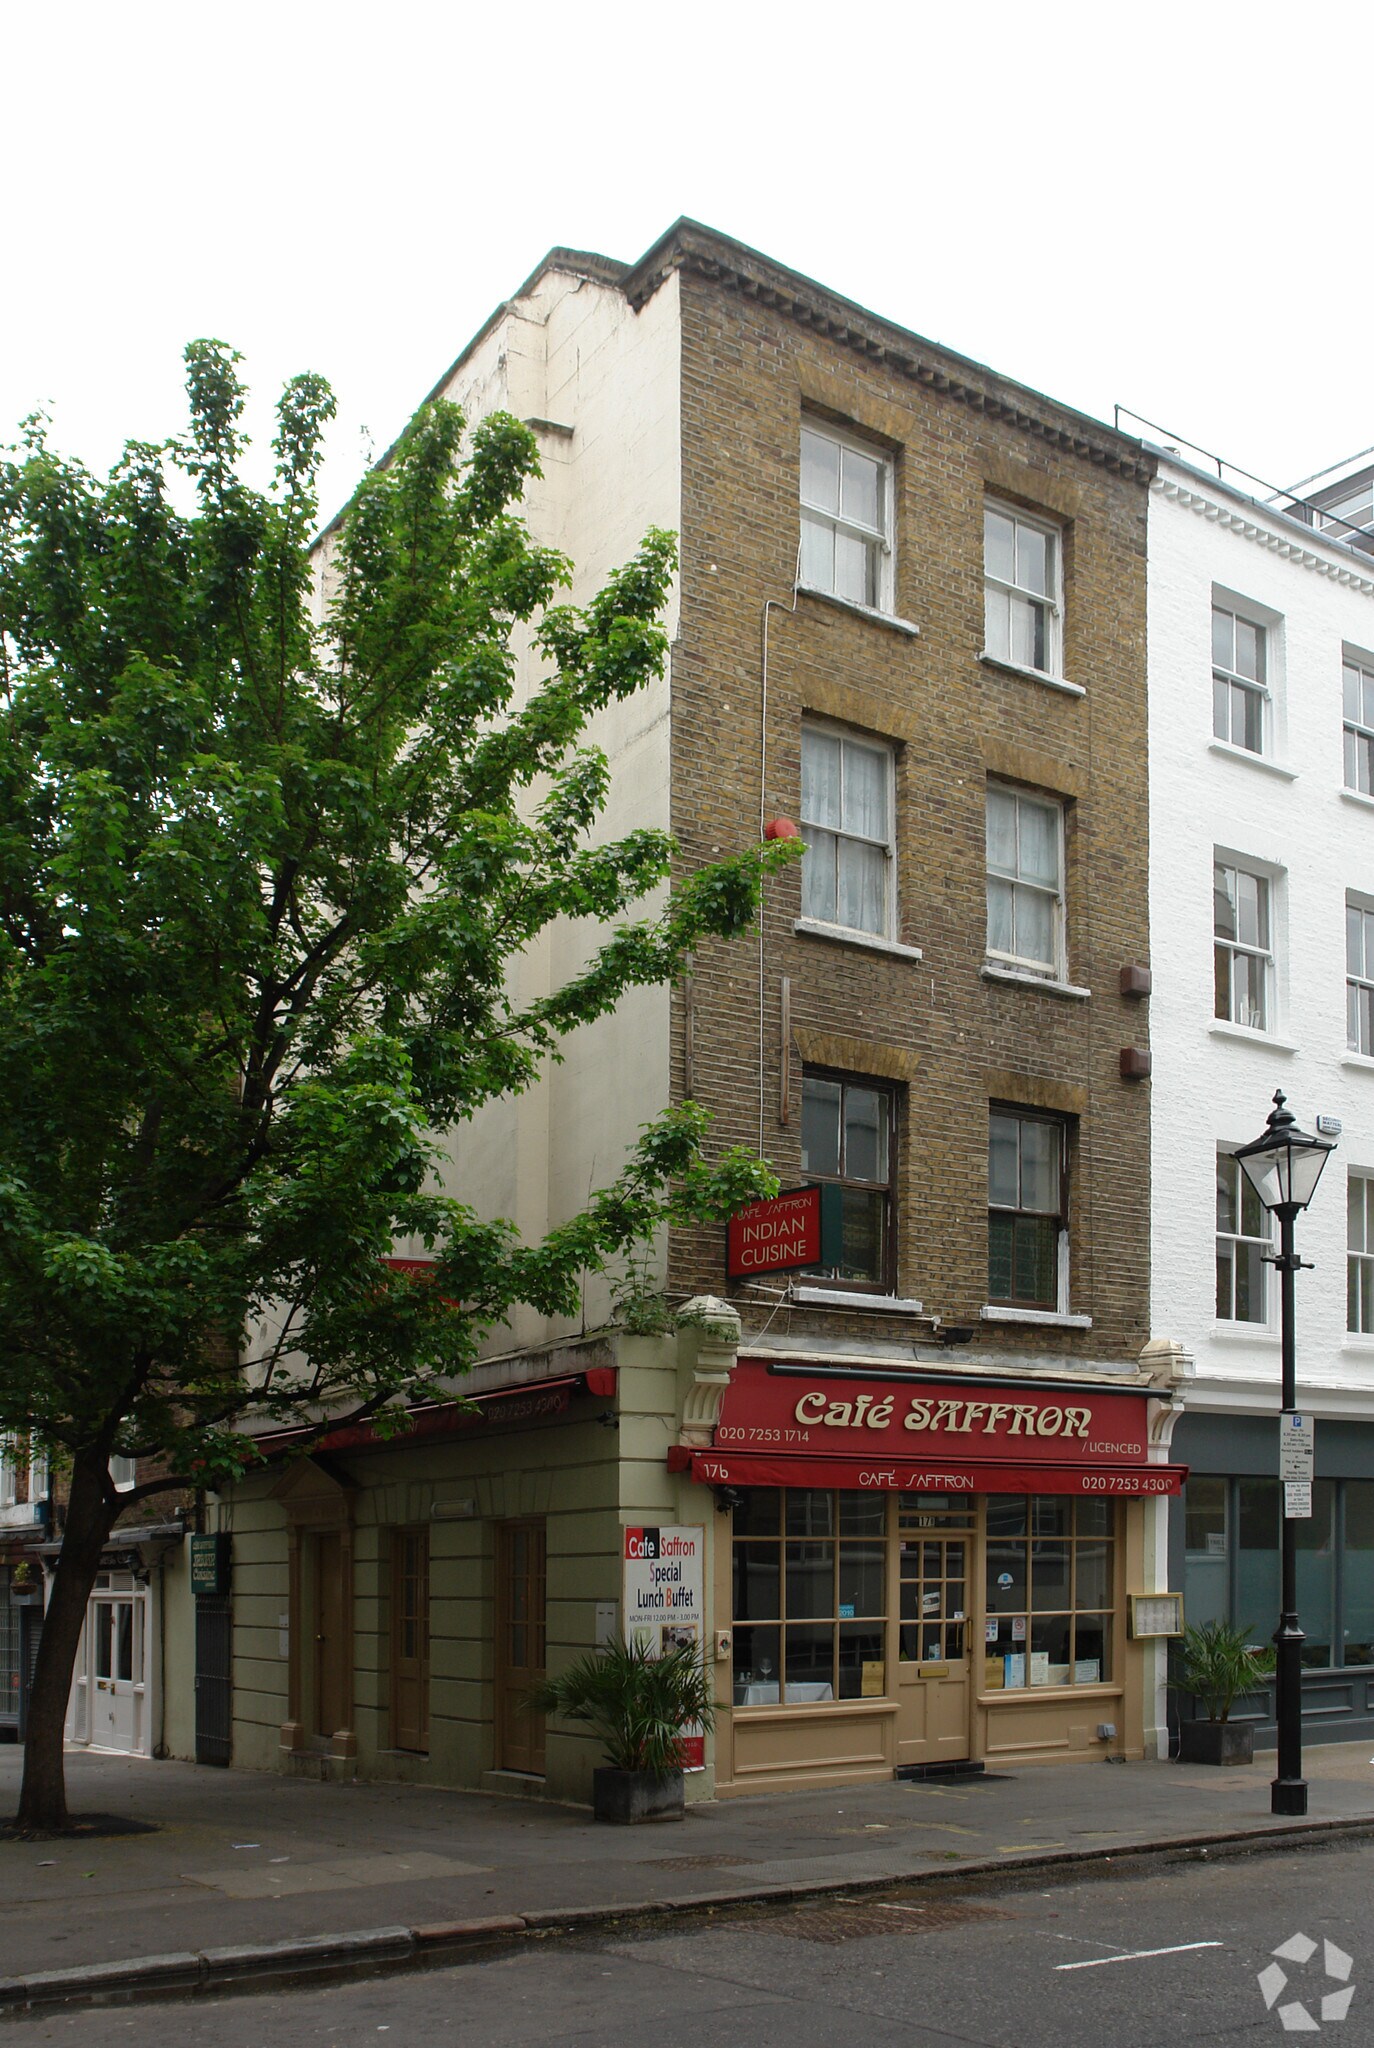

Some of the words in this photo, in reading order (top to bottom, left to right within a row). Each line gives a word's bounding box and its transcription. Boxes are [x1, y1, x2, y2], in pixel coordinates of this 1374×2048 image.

[766, 1197, 812, 1216] SAFFRON
[743, 1216, 805, 1243] INDIAN
[741, 1240, 807, 1266] CUISINE
[795, 1392, 894, 1429] Café
[904, 1398, 1093, 1439] SAFFRON
[719, 1427, 745, 1442] 020
[749, 1427, 782, 1442] 7253
[784, 1428, 810, 1443] 1714
[1089, 1442, 1142, 1454] LICENCED
[704, 1464, 729, 1479] 17b
[905, 1474, 974, 1489] SAFFRON
[1082, 1476, 1106, 1489] 020
[1109, 1477, 1139, 1490] 7253
[1142, 1479, 1173, 1491] 4300
[628, 1536, 655, 1558] Cafe
[660, 1536, 695, 1557] Saffron
[649, 1561, 682, 1587] Special
[637, 1588, 664, 1609] Lunch
[666, 1587, 694, 1608] Buffet
[839, 1609, 854, 1618] 2010
